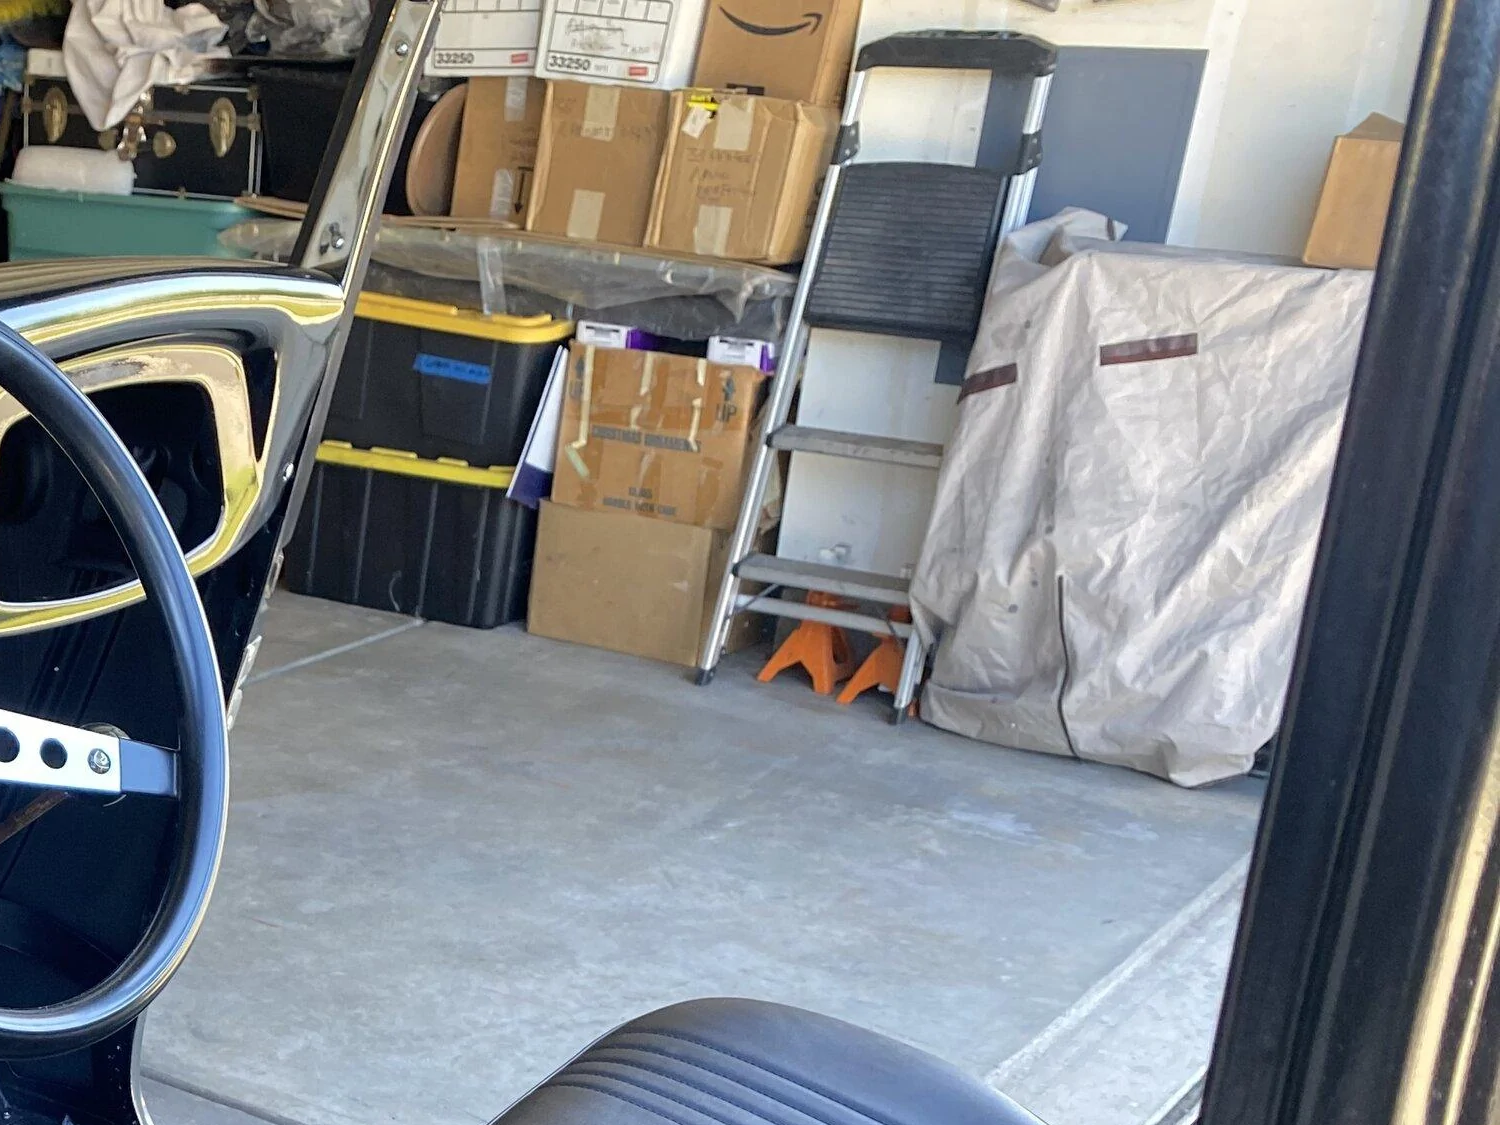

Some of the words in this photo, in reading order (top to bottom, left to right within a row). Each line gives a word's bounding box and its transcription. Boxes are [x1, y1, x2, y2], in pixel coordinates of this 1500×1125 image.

[435, 52, 474, 65] 33250
[549, 55, 591, 71] 33250
[716, 403, 737, 423] UP
